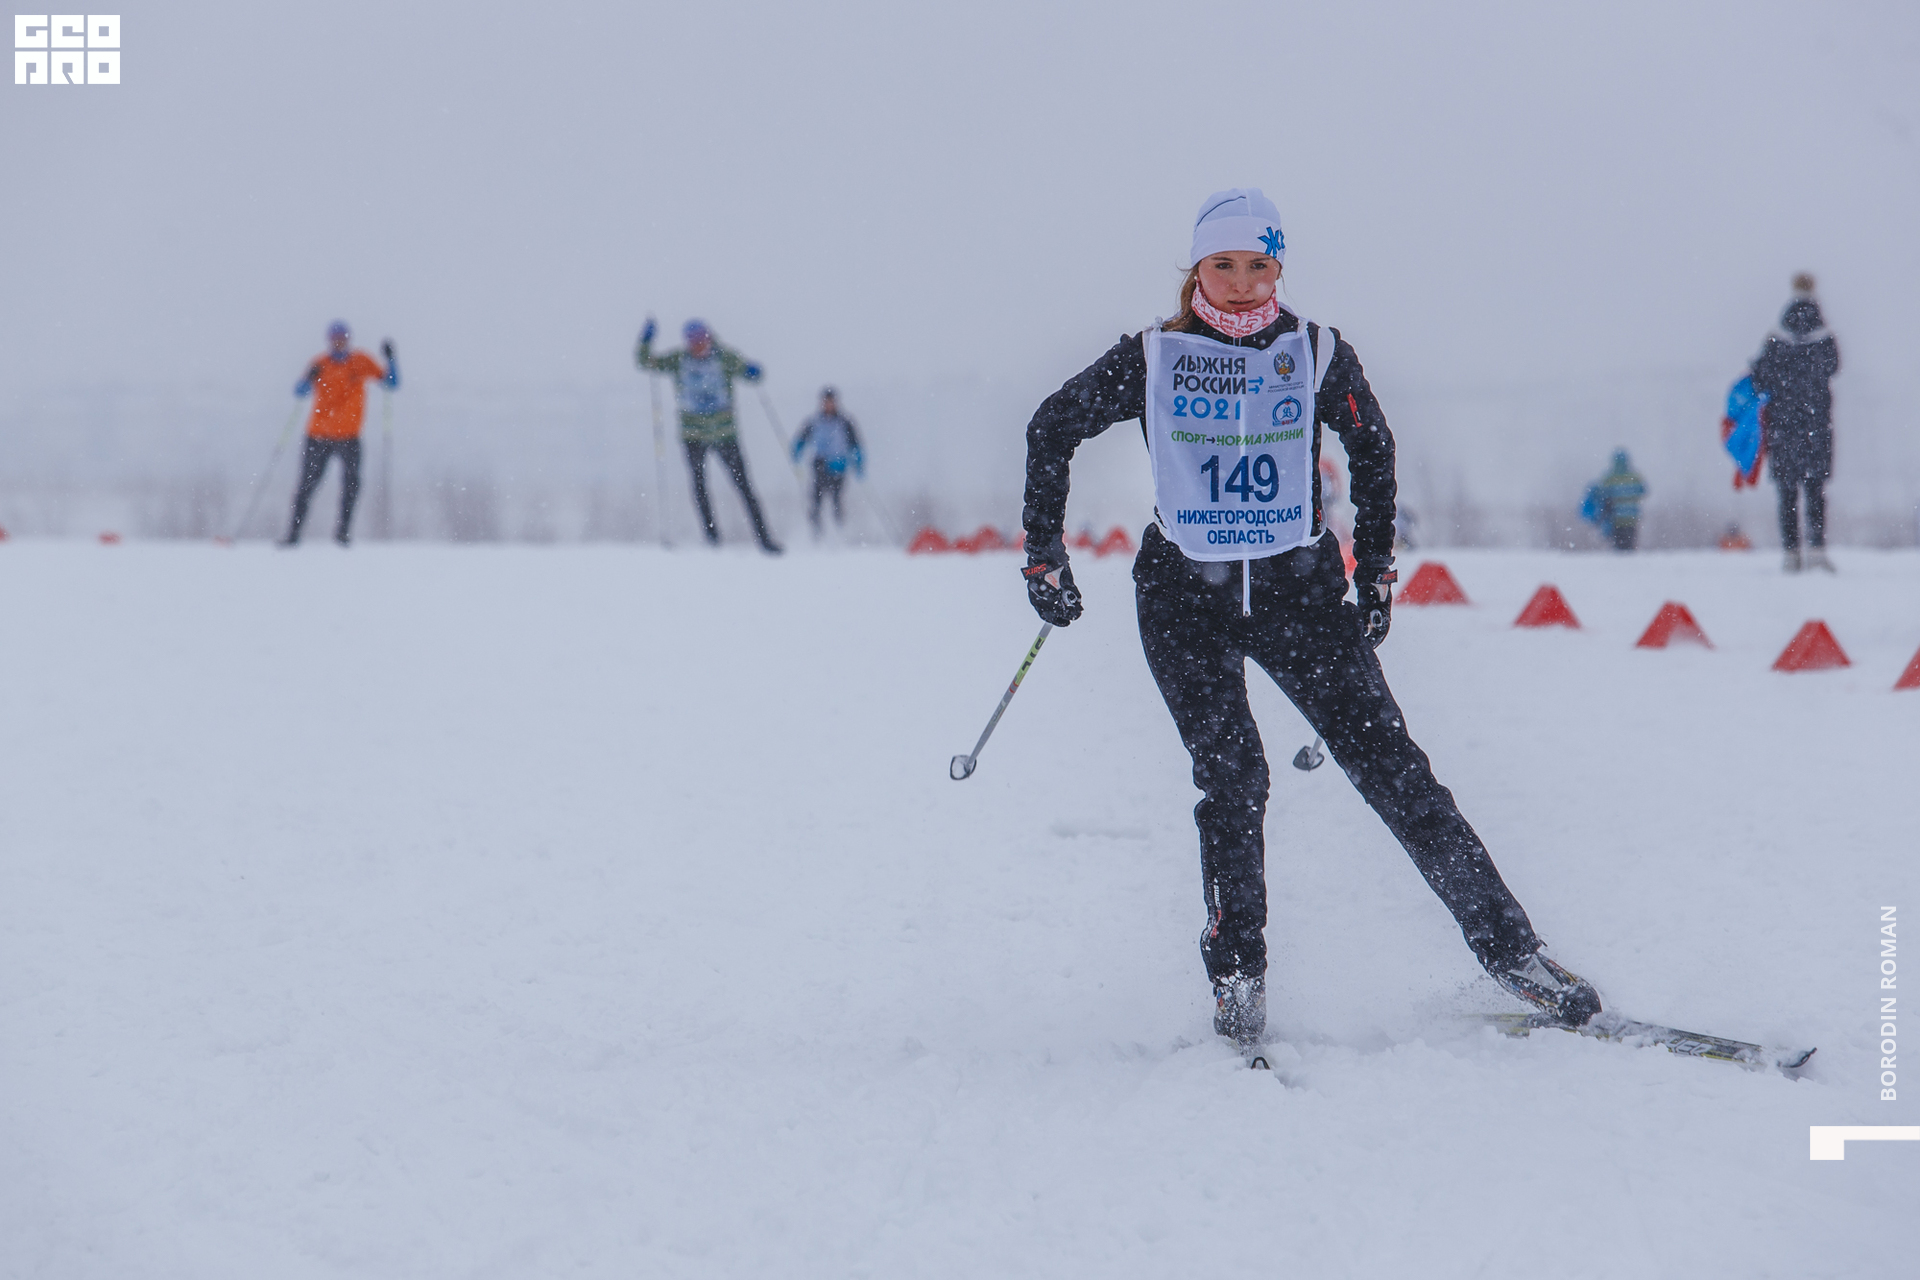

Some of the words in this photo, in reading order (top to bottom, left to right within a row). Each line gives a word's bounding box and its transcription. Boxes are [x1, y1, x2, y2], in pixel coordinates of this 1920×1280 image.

[1172, 354, 1246, 375] ЛЫЖНЯ
[1173, 373, 1246, 395] РОССИИ
[1172, 395, 1241, 420] 2021
[1171, 430, 1207, 445] СПОРТ
[1216, 433, 1262, 446] НОРМА
[1263, 427, 1304, 444] ЖИЗНИ
[1200, 453, 1280, 503] 149
[1177, 505, 1302, 527] НИЖЕГОРОДСКАЯ
[1207, 529, 1275, 545] ОБЛАСТЬ
